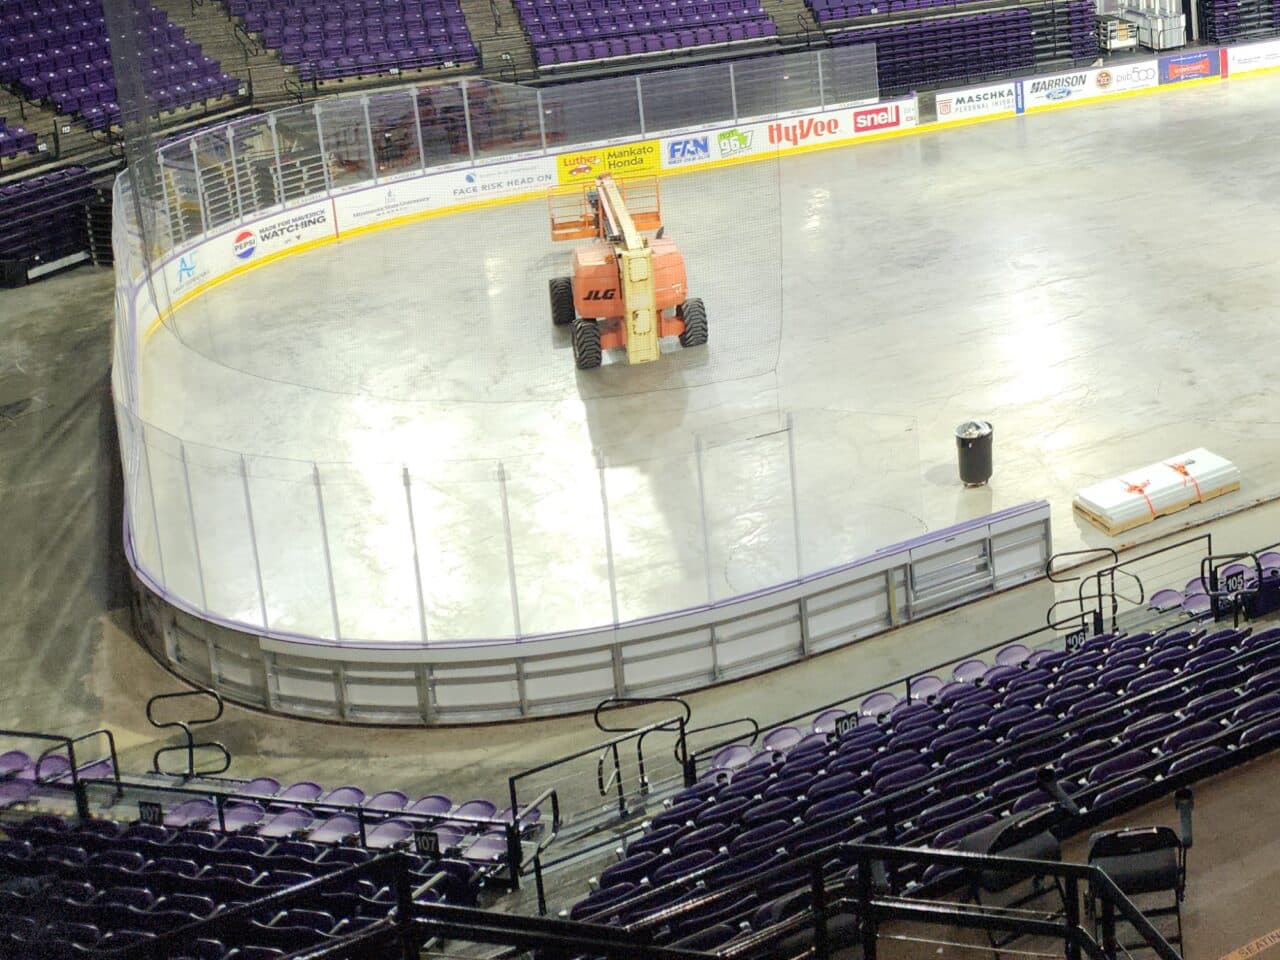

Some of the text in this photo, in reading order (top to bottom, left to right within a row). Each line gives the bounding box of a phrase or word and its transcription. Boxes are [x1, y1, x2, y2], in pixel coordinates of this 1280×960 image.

[956, 89, 1014, 104] MASCHKA
[856, 105, 895, 128] snell
[607, 146, 654, 160] Mankato
[670, 136, 708, 158] FAN
[608, 156, 644, 169] Honda
[453, 186, 477, 195] FACE
[481, 182, 504, 191] RISK
[507, 177, 534, 186] HEAD
[261, 216, 326, 242] WATCHING
[235, 240, 255, 250] PEPSI
[583, 288, 617, 301] JLG
[1228, 576, 1243, 590] 105
[1068, 632, 1085, 647] 106
[836, 716, 860, 735] 106
